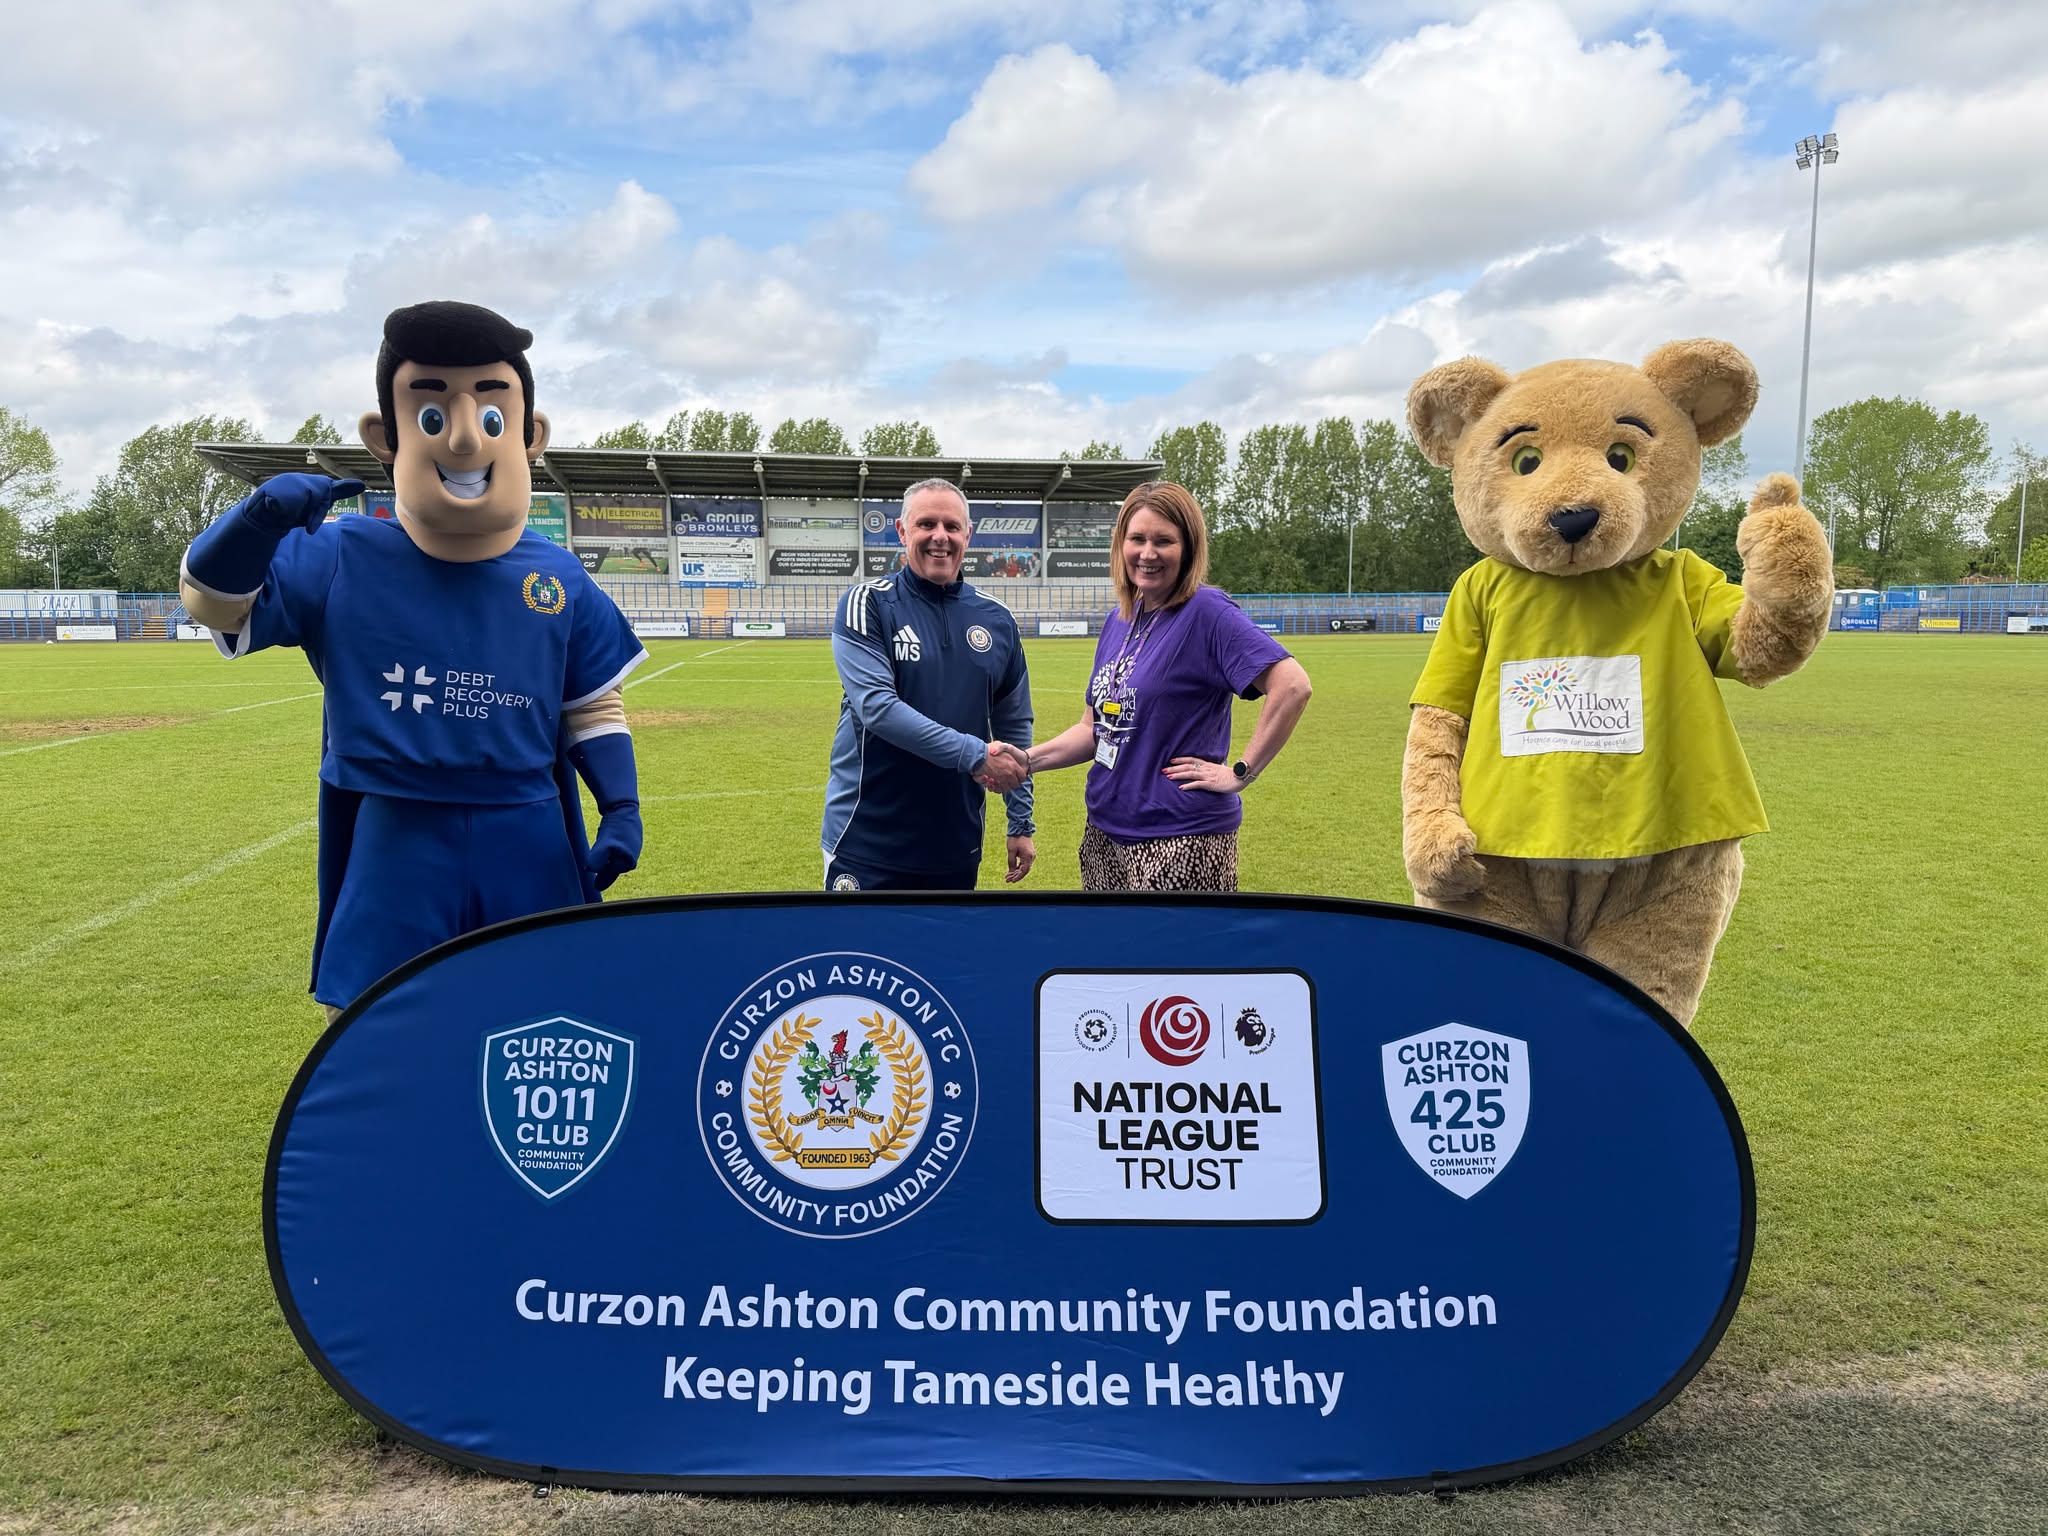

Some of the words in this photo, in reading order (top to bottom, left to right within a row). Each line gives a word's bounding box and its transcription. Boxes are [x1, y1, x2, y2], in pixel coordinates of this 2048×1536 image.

[332, 505, 358, 514] Centre
[608, 509, 660, 518] ELECTRICAL
[688, 524, 758, 533] BROMLEYS
[980, 519, 1032, 531] EMJFL
[42, 596, 76, 610] SACK
[895, 642, 921, 662] MS
[446, 670, 496, 687] DEBT
[444, 687, 533, 709] RECOVERY
[1553, 692, 1631, 711] Willow
[442, 702, 489, 719] PLUS
[1568, 710, 1631, 729] Wood
[1522, 736, 1551, 747] Hospice
[1552, 737, 1568, 745] care
[1570, 737, 1581, 746] for
[1583, 738, 1602, 748] local
[1603, 737, 1627, 749] people
[720, 969, 816, 1060] CURZON
[827, 965, 938, 1024] ASHTON
[932, 1026, 961, 1063] FC
[503, 1037, 613, 1062] CURZON
[1397, 1040, 1510, 1064] CURZON
[504, 1060, 609, 1084] ASHTON
[1404, 1063, 1509, 1086] ASHTON
[513, 1085, 595, 1121] 1011
[1073, 1081, 1281, 1114] NATIONAL
[796, 1110, 820, 1125] LABOR
[823, 1117, 849, 1125] OMNIA
[1410, 1089, 1505, 1130] 425
[516, 1123, 589, 1146] CLUB
[1098, 1119, 1259, 1151] LEAGUE
[1428, 1133, 1496, 1154] CLUB
[518, 1149, 585, 1161] COMMUNITY
[802, 1153, 847, 1164] FOUNDED
[849, 1153, 871, 1163] 1963
[1430, 1157, 1497, 1167] COMMUNITY
[519, 1160, 583, 1171] FOUNDATION
[712, 1112, 829, 1225] COMMUNITY
[835, 1112, 963, 1226] FOUNDATION
[1116, 1158, 1243, 1190] TRUST
[1433, 1166, 1495, 1176] FOUNDATION
[515, 1278, 685, 1326] Curzon
[700, 1284, 878, 1329] Ashton
[893, 1287, 1191, 1345] Community
[1205, 1286, 1497, 1333] Foundation
[663, 1356, 871, 1415] Keeping
[884, 1360, 1130, 1406] Tameside
[1145, 1359, 1345, 1416] Healthy
